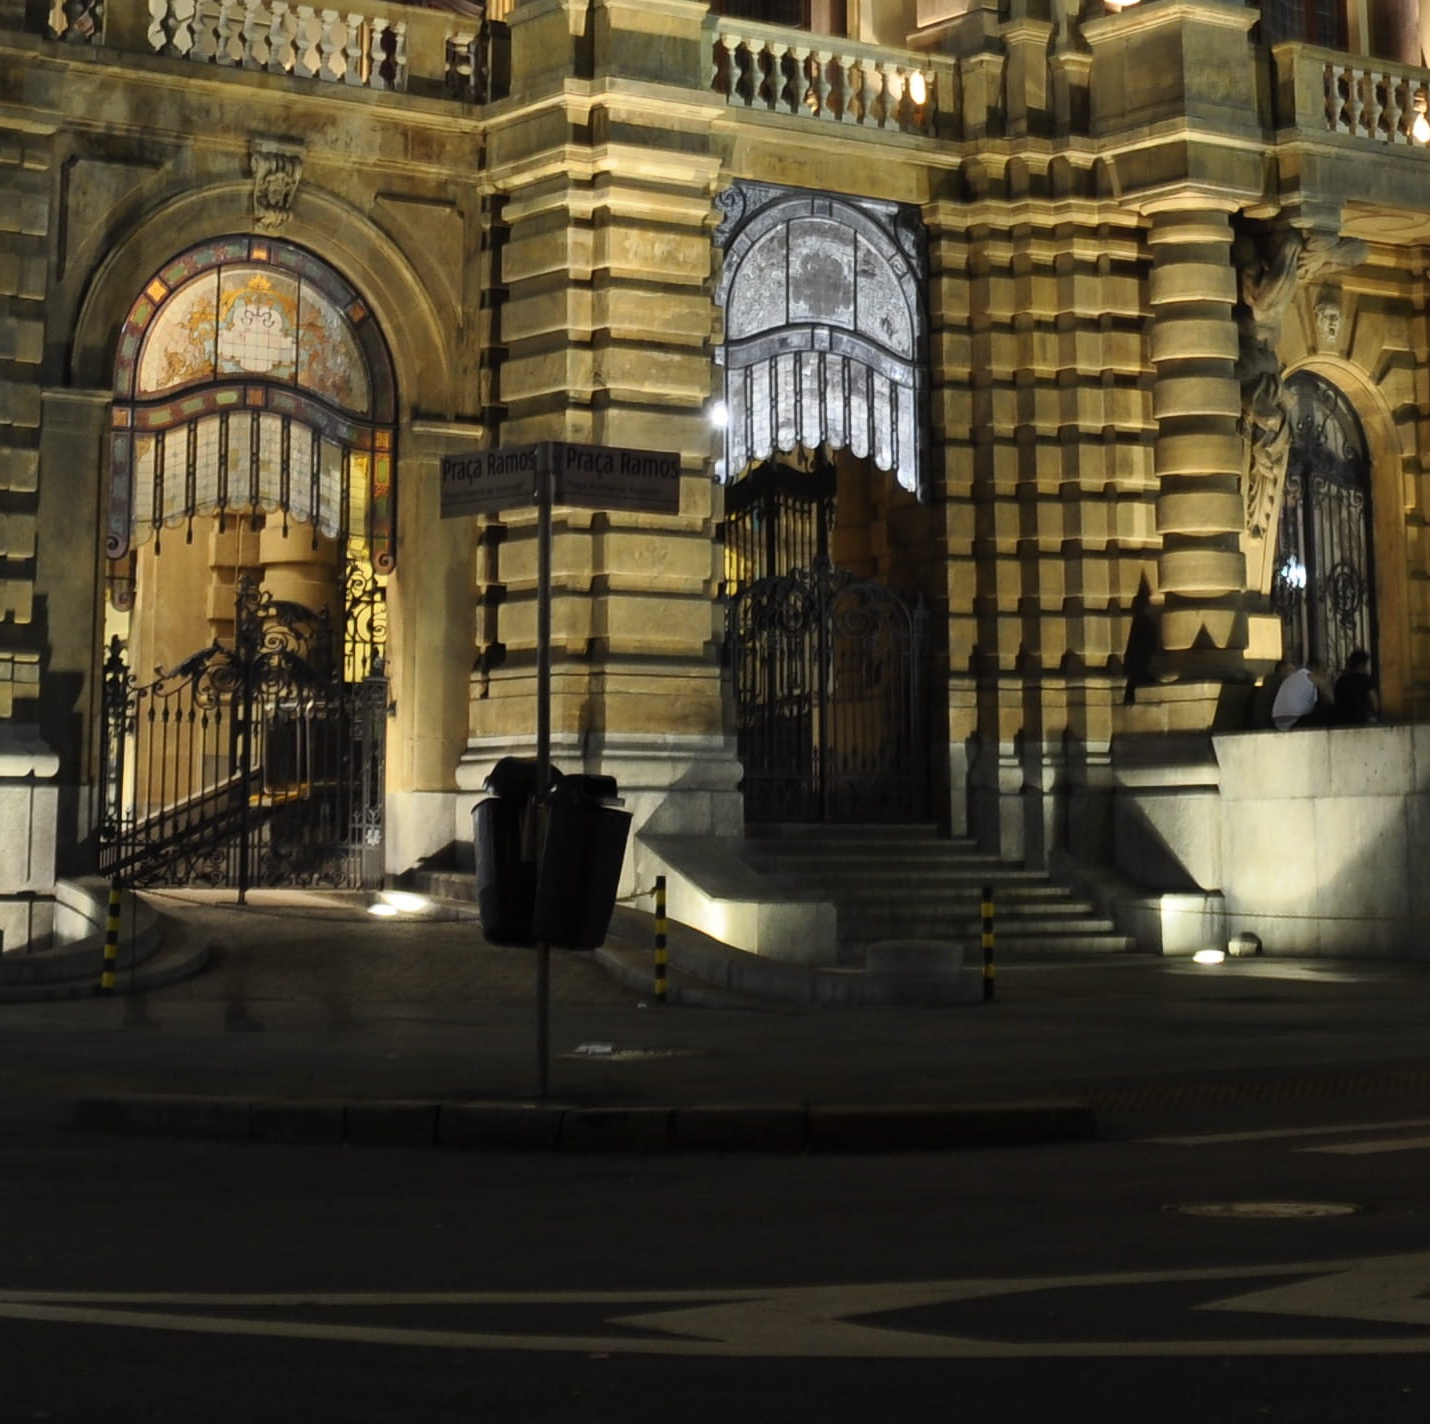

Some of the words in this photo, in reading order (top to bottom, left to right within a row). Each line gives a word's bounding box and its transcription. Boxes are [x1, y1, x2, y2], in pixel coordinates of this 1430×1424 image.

[442, 459, 482, 485] Praça
[566, 447, 613, 479] Praça
[620, 452, 679, 479] Ramos
